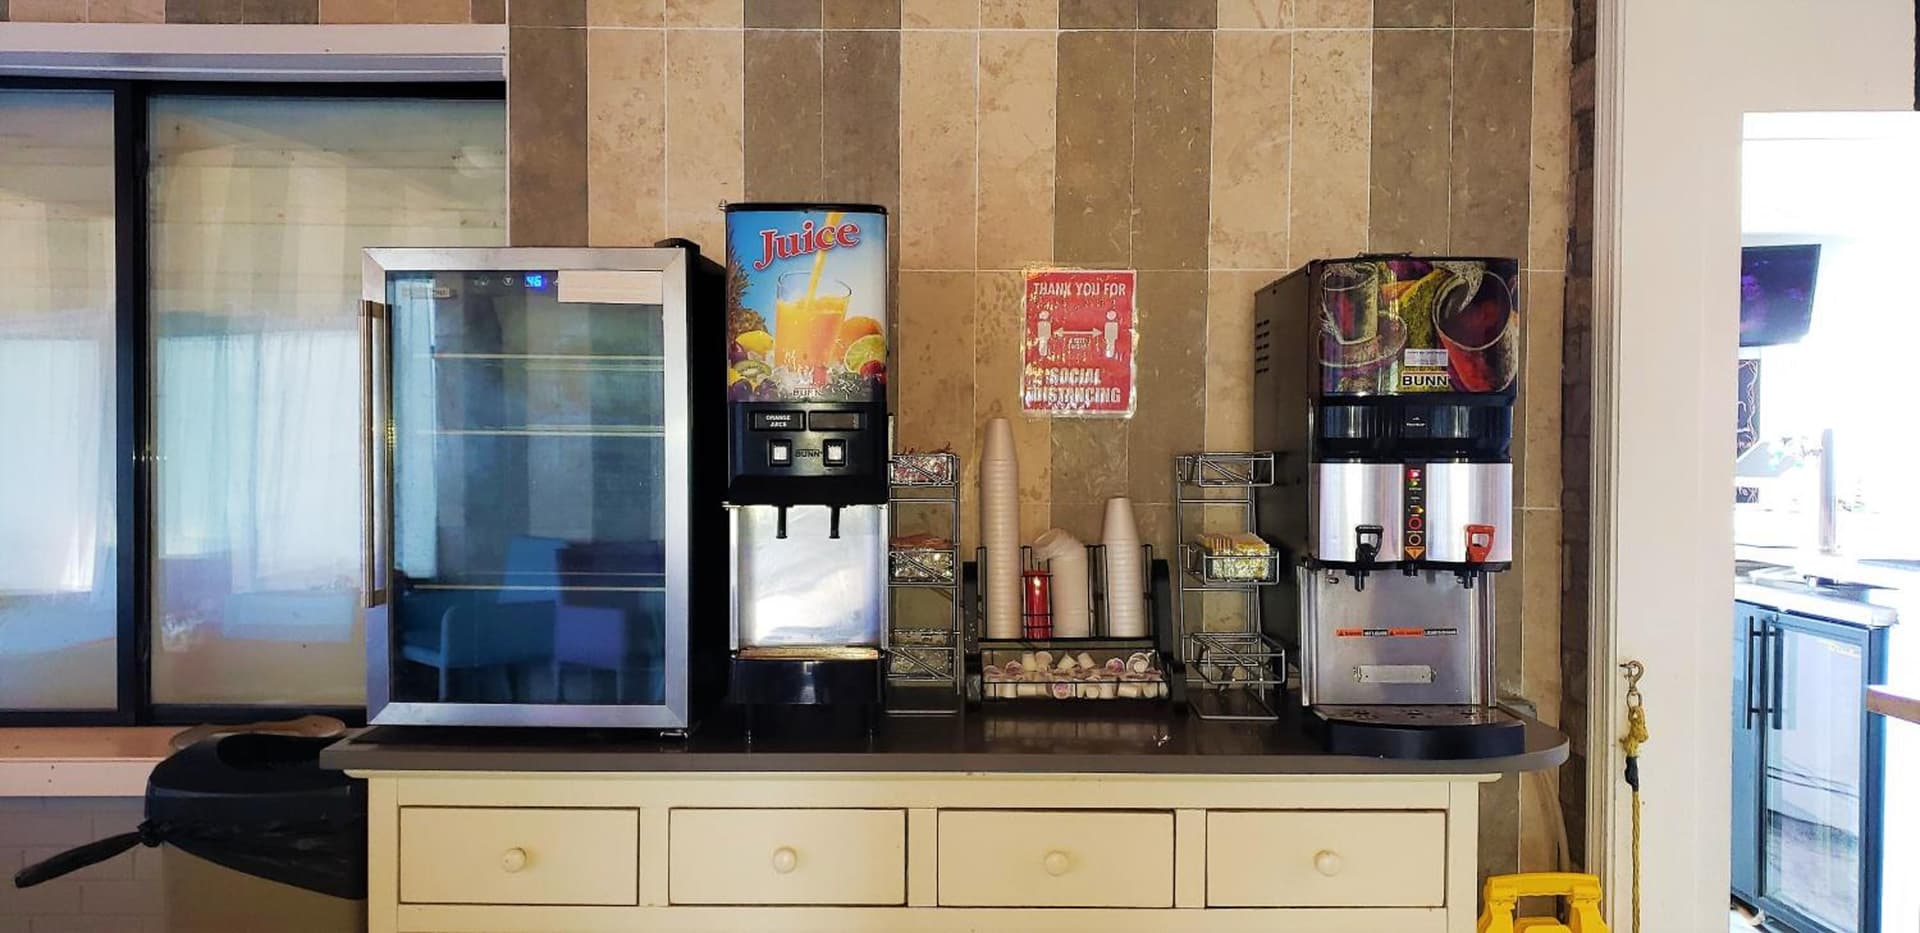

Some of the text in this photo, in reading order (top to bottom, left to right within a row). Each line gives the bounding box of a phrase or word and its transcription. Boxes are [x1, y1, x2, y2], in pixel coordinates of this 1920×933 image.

[753, 219, 861, 271] Juice
[525, 275, 542, 287] 46
[1033, 282, 1126, 297] THANK YOU FOR
[1048, 367, 1102, 384] SOCIAL
[1402, 375, 1447, 386] BUNN
[1033, 386, 1121, 404] DISTANCING
